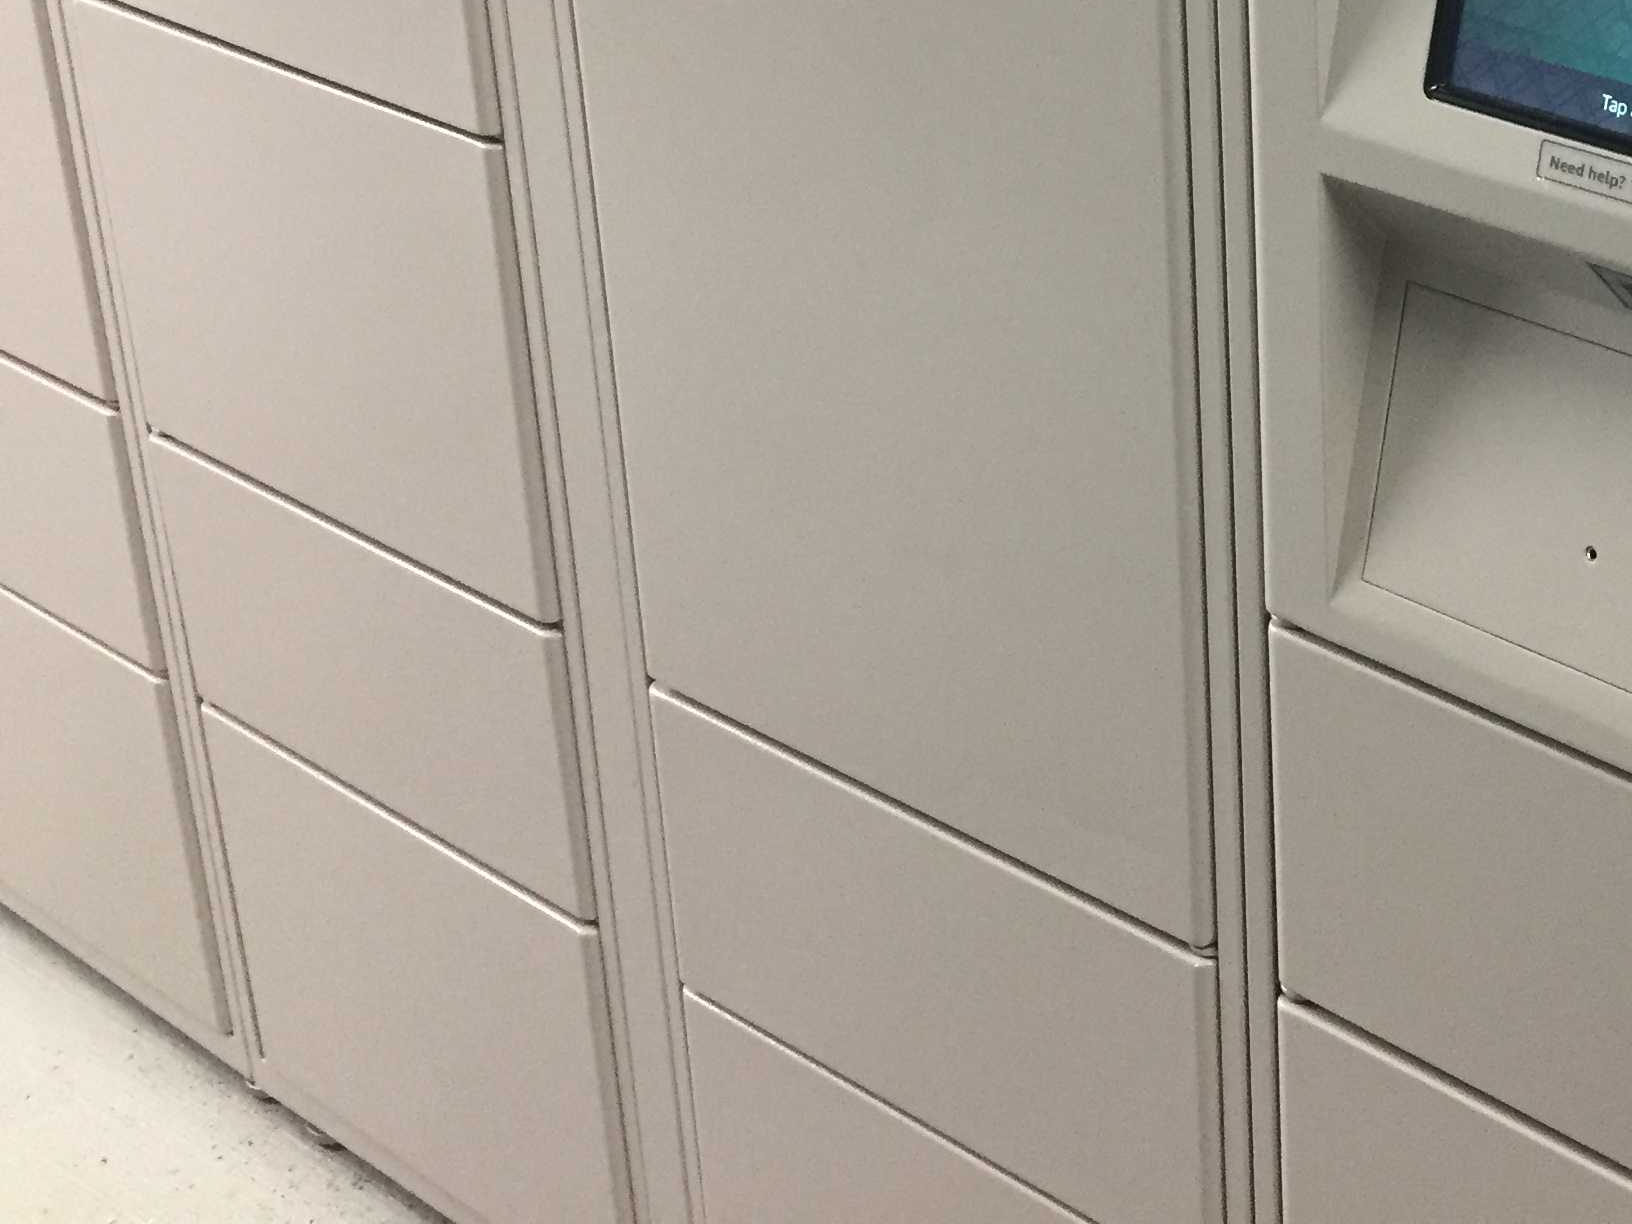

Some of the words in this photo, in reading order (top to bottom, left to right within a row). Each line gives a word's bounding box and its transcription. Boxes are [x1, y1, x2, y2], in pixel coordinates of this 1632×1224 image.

[1602, 93, 1628, 118] Tap
[1549, 155, 1585, 178] Need
[1588, 165, 1627, 190] help?
